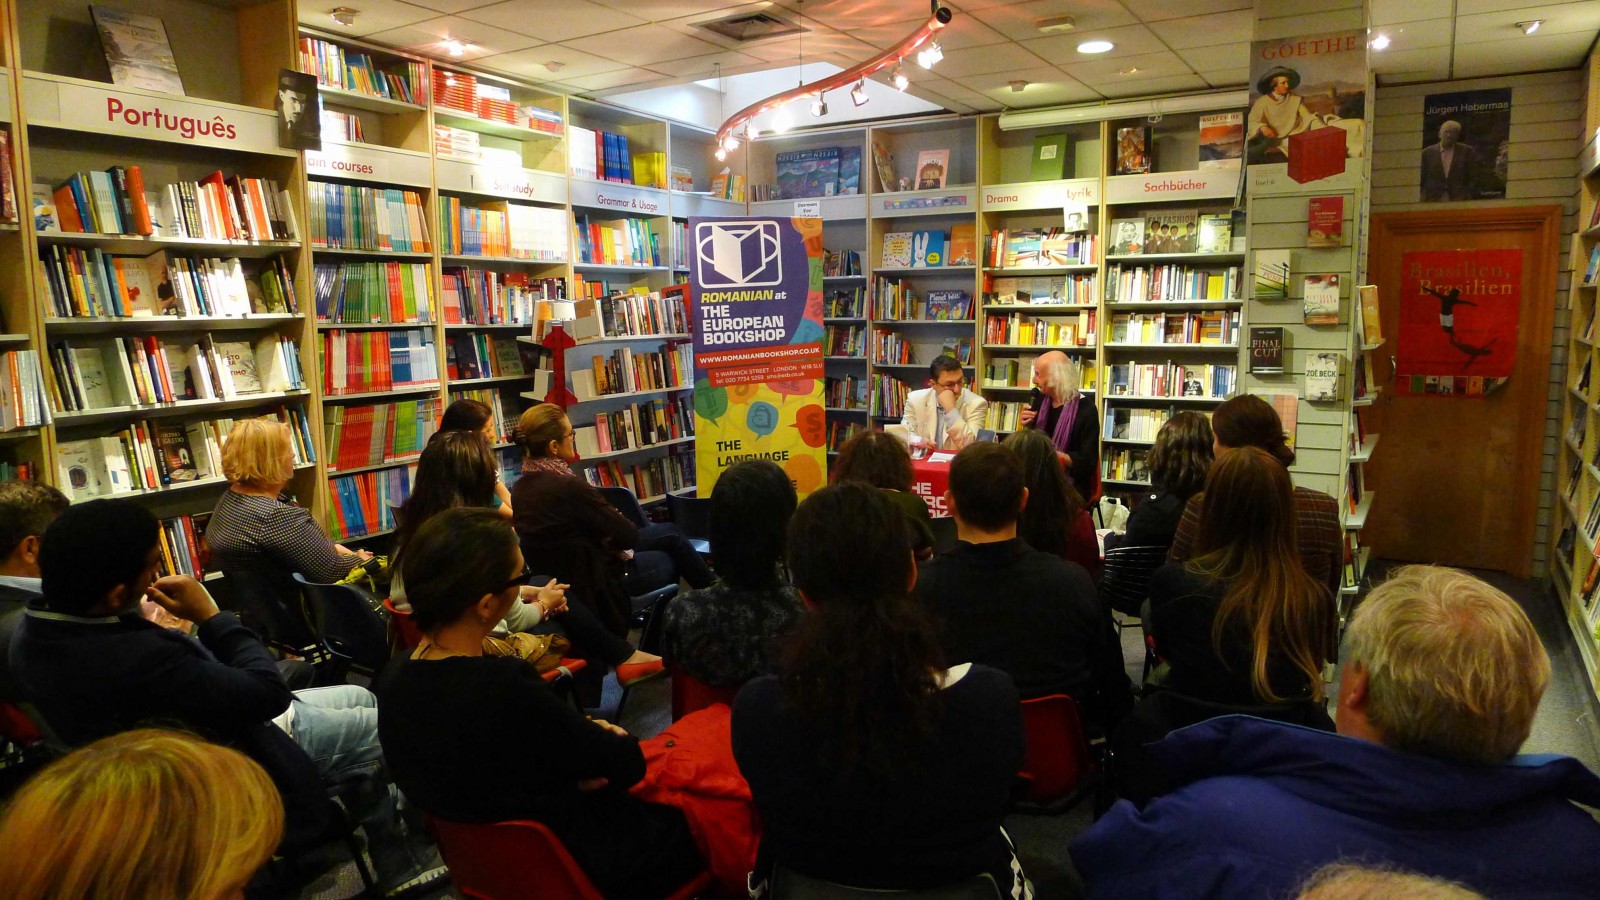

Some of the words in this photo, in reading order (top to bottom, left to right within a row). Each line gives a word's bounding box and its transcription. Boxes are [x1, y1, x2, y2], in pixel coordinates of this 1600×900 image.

[1261, 36, 1357, 61] GOETHE
[1426, 105, 1458, 115] Jürgen
[1460, 102, 1509, 112] Habermas
[106, 97, 237, 140] Português
[308, 158, 326, 168] ain
[331, 161, 374, 174] courses
[1144, 179, 1207, 193] Sachbücher
[986, 194, 1018, 204] Drama
[1066, 187, 1092, 200] Lyrik
[597, 195, 629, 208] Grammar
[631, 199, 637, 208] &
[639, 200, 658, 212] Usage
[1418, 278, 1513, 296] Brasilien
[701, 290, 773, 303] ROMANIAN
[774, 291, 787, 300] at
[701, 305, 730, 319] THE
[702, 315, 784, 332] EUROPEAN
[703, 329, 786, 346] BOOKSHOP
[1252, 339, 1280, 348] FINAL
[700, 347, 820, 364] WWW.ROMANIANBOOKSHOP.CO.UK
[1254, 348, 1279, 358] CUT
[720, 369, 748, 377] WARWICK
[773, 365, 797, 373] LONDON
[716, 440, 742, 452] THE
[911, 482, 932, 495] HE
